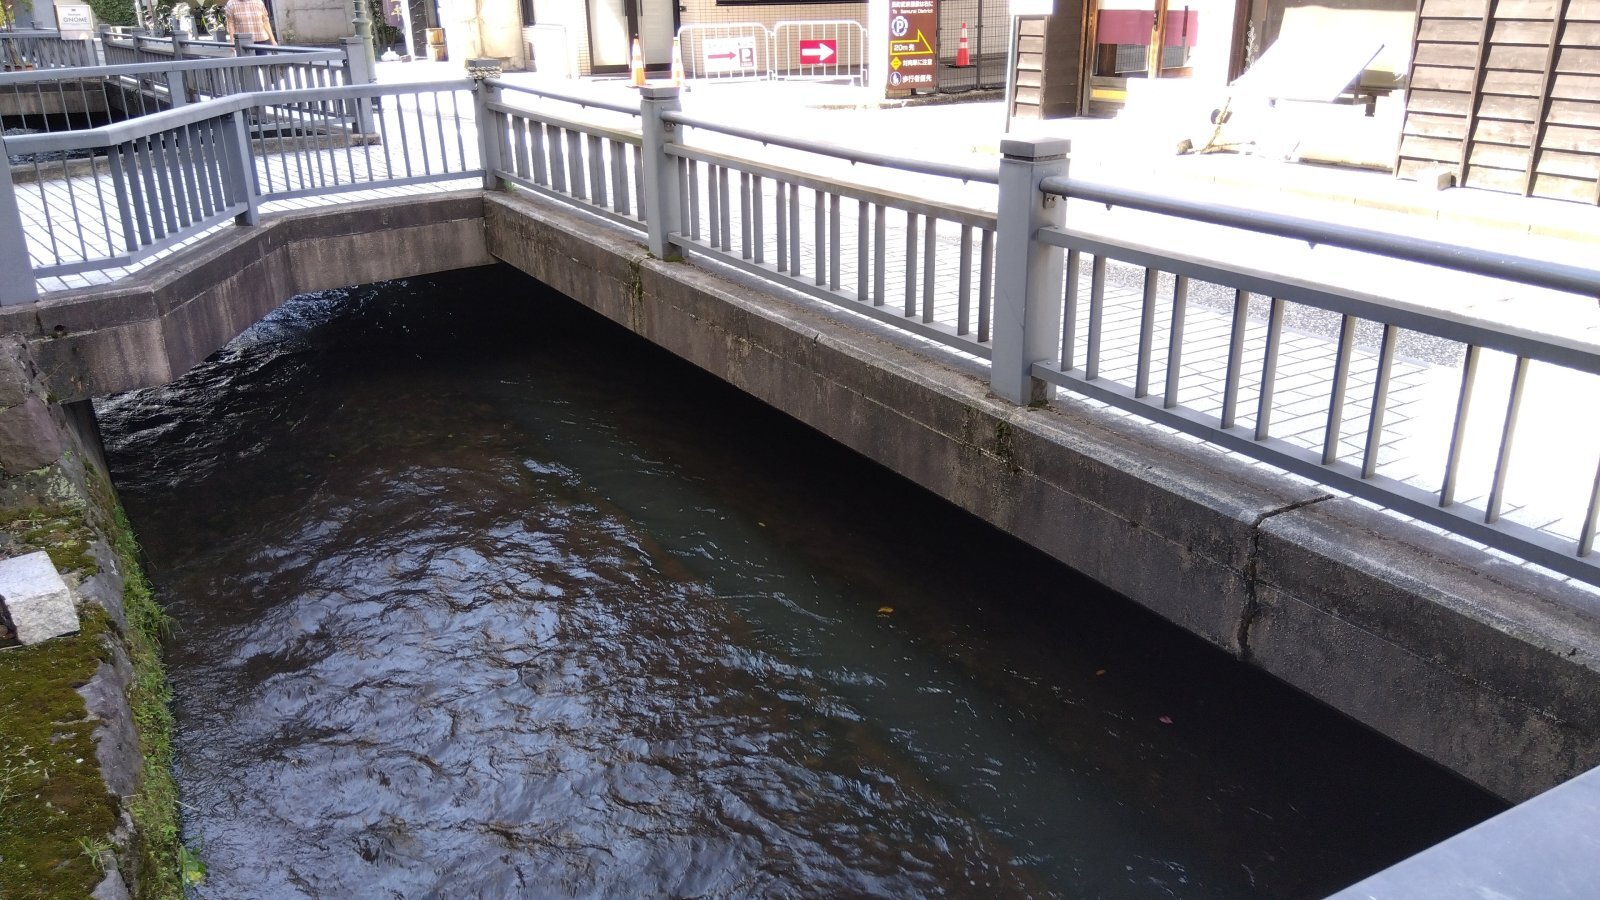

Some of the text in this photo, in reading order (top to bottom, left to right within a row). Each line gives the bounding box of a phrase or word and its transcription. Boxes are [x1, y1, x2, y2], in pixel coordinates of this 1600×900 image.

[896, 20, 904, 32] P
[903, 75, 932, 83] 歩行者優先
